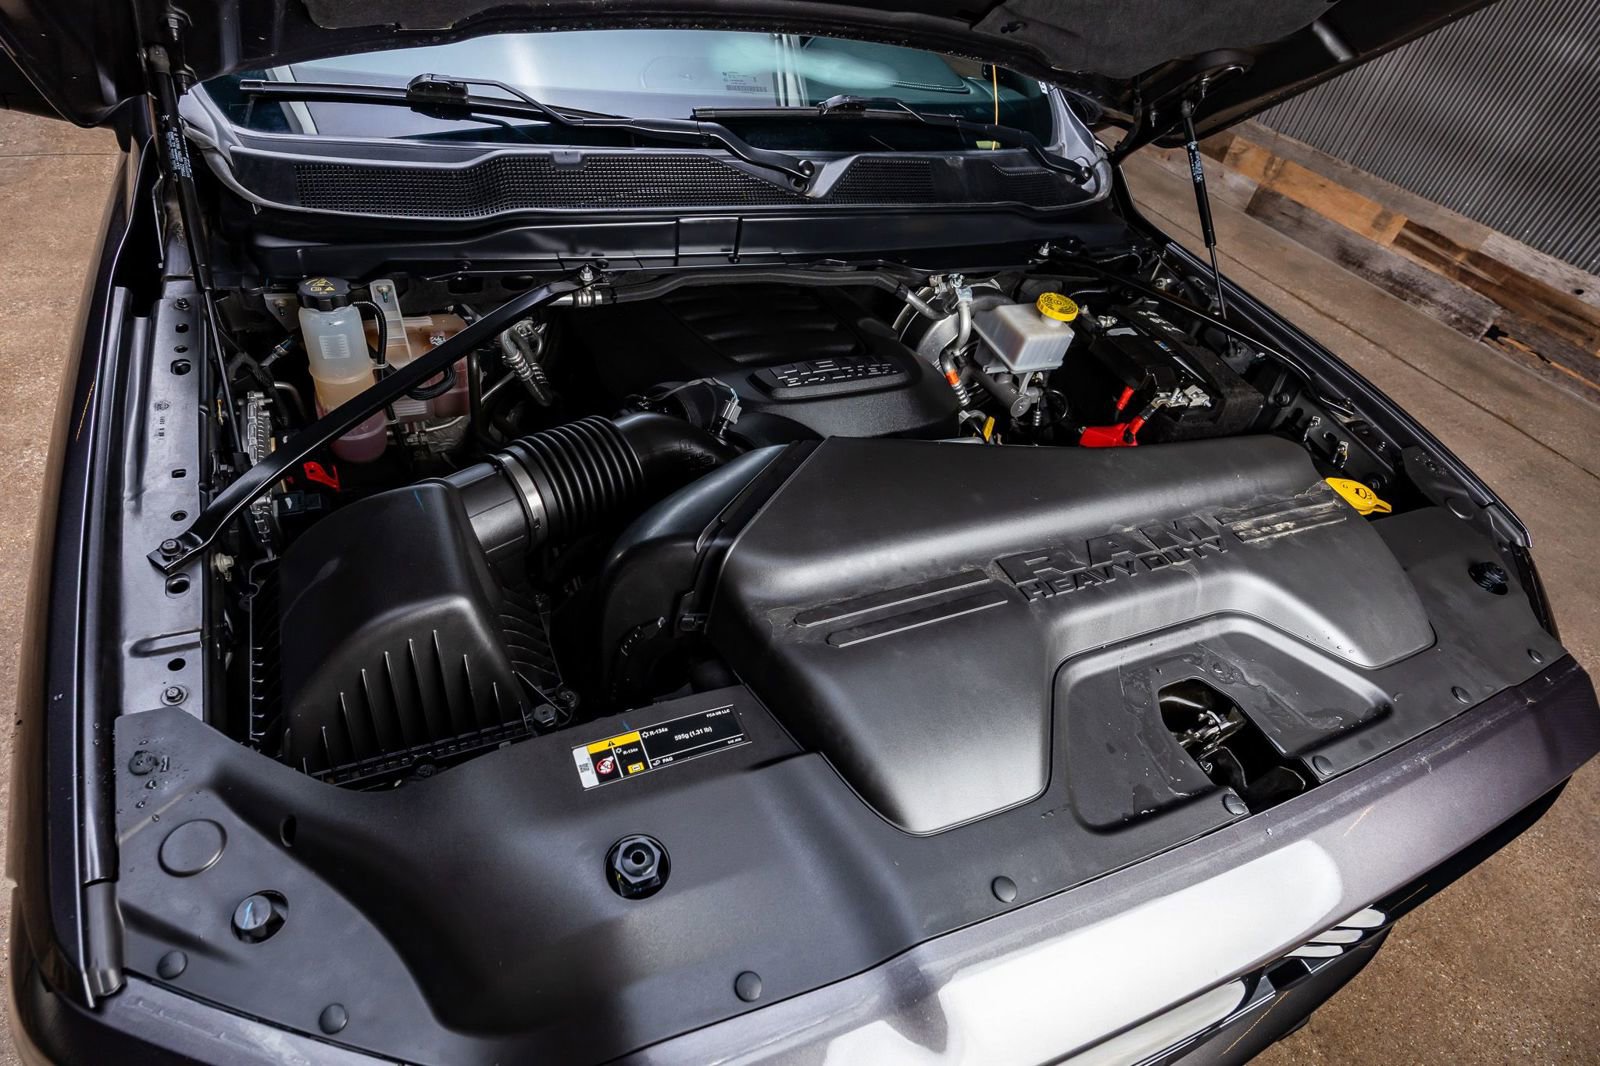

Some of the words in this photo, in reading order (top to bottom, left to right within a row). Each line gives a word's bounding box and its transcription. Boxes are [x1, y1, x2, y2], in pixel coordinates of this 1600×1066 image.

[993, 513, 1222, 586] RAM
[1016, 559, 1138, 602] HEAVY
[1139, 538, 1229, 572] DUTY
[649, 727, 669, 737] R-134a
[689, 727, 704, 738] (1.31
[703, 725, 713, 733] lb)
